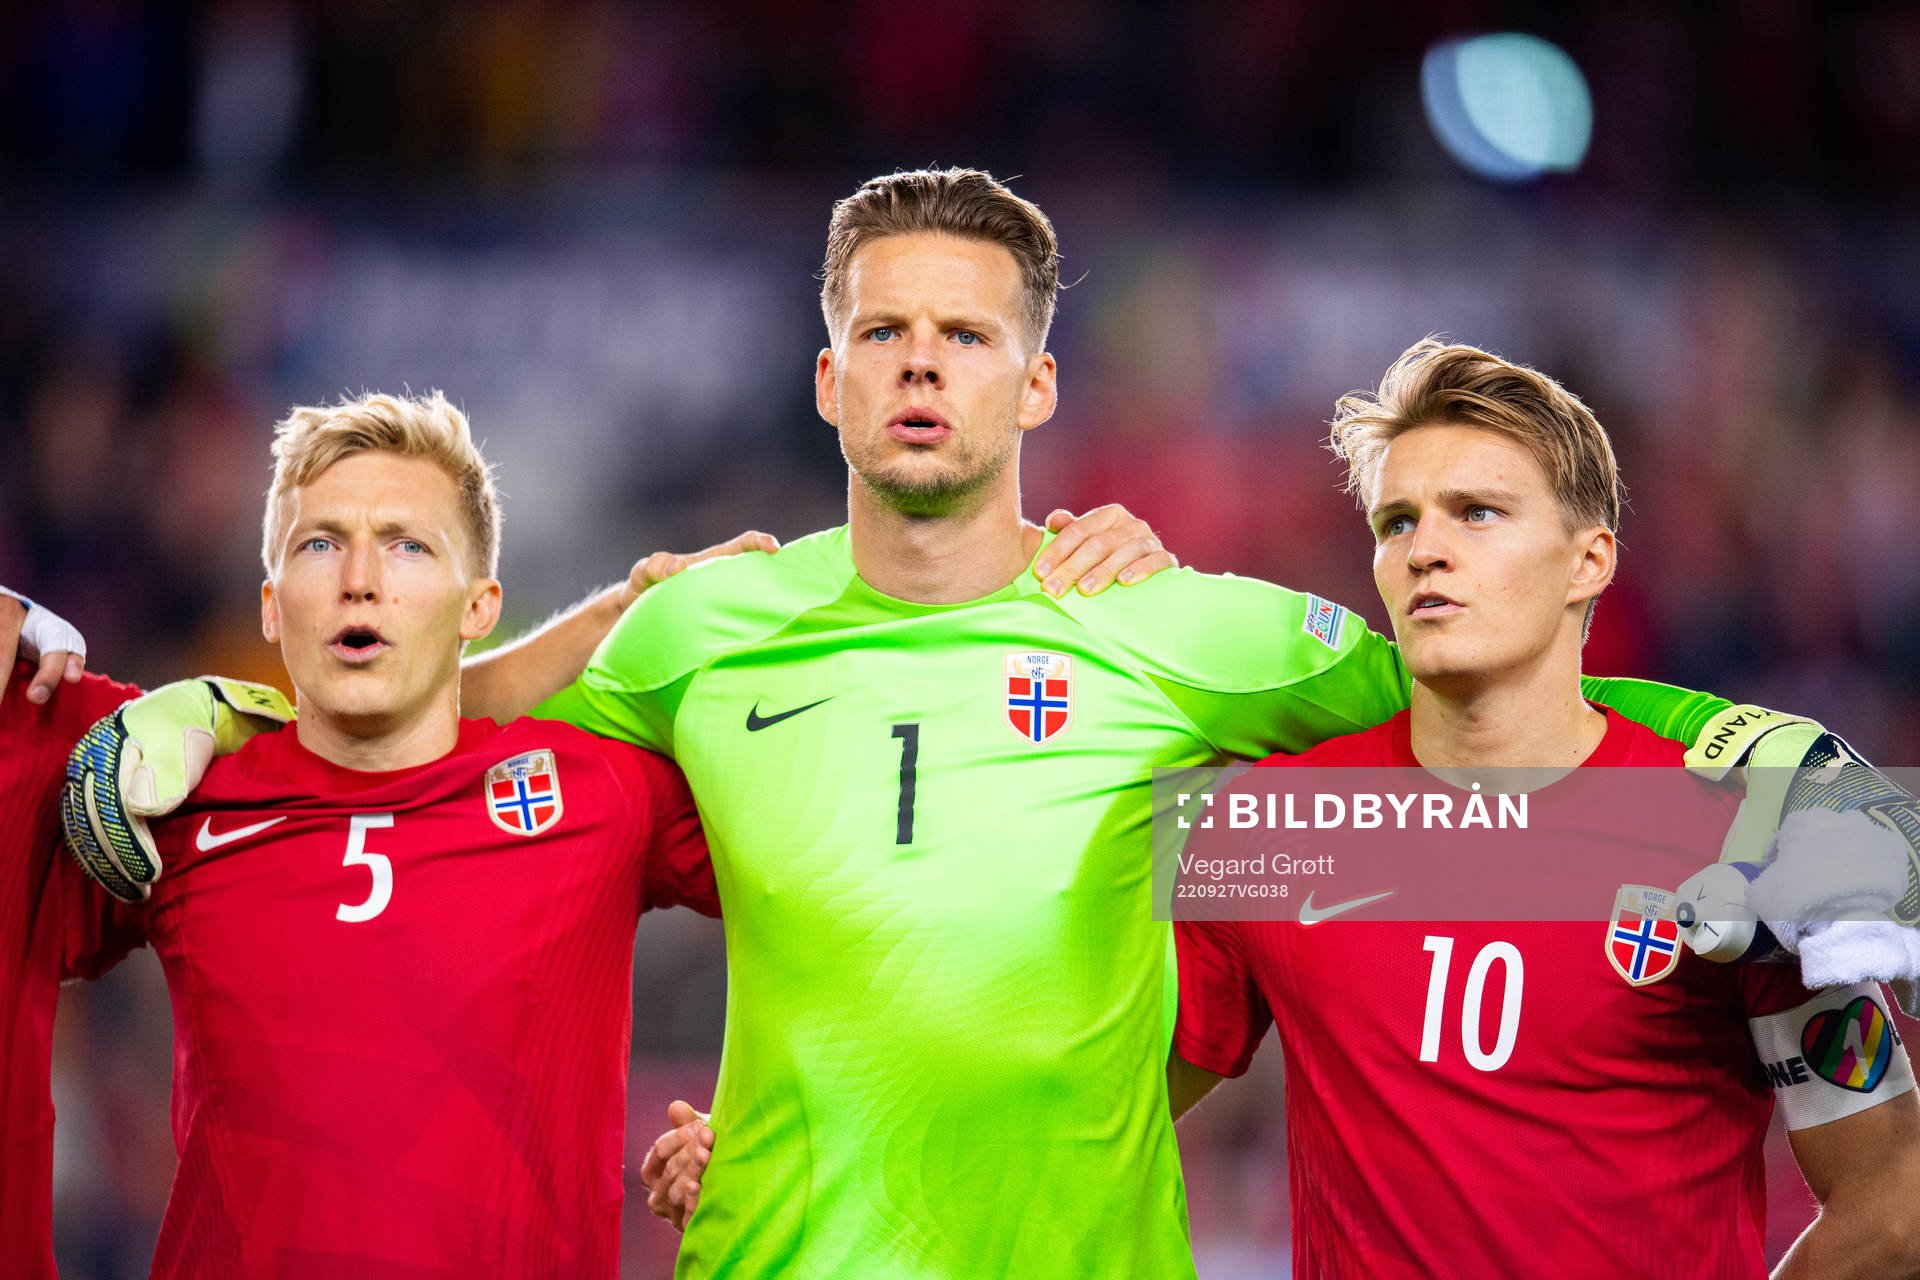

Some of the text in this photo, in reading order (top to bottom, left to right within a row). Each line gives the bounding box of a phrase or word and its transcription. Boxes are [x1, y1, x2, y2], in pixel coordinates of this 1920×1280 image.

[1026, 655, 1050, 665] NORGE
[890, 722, 920, 845] 1
[336, 812, 395, 923] 5
[1643, 891, 1667, 904] NORGE
[1419, 935, 1525, 1072] 10
